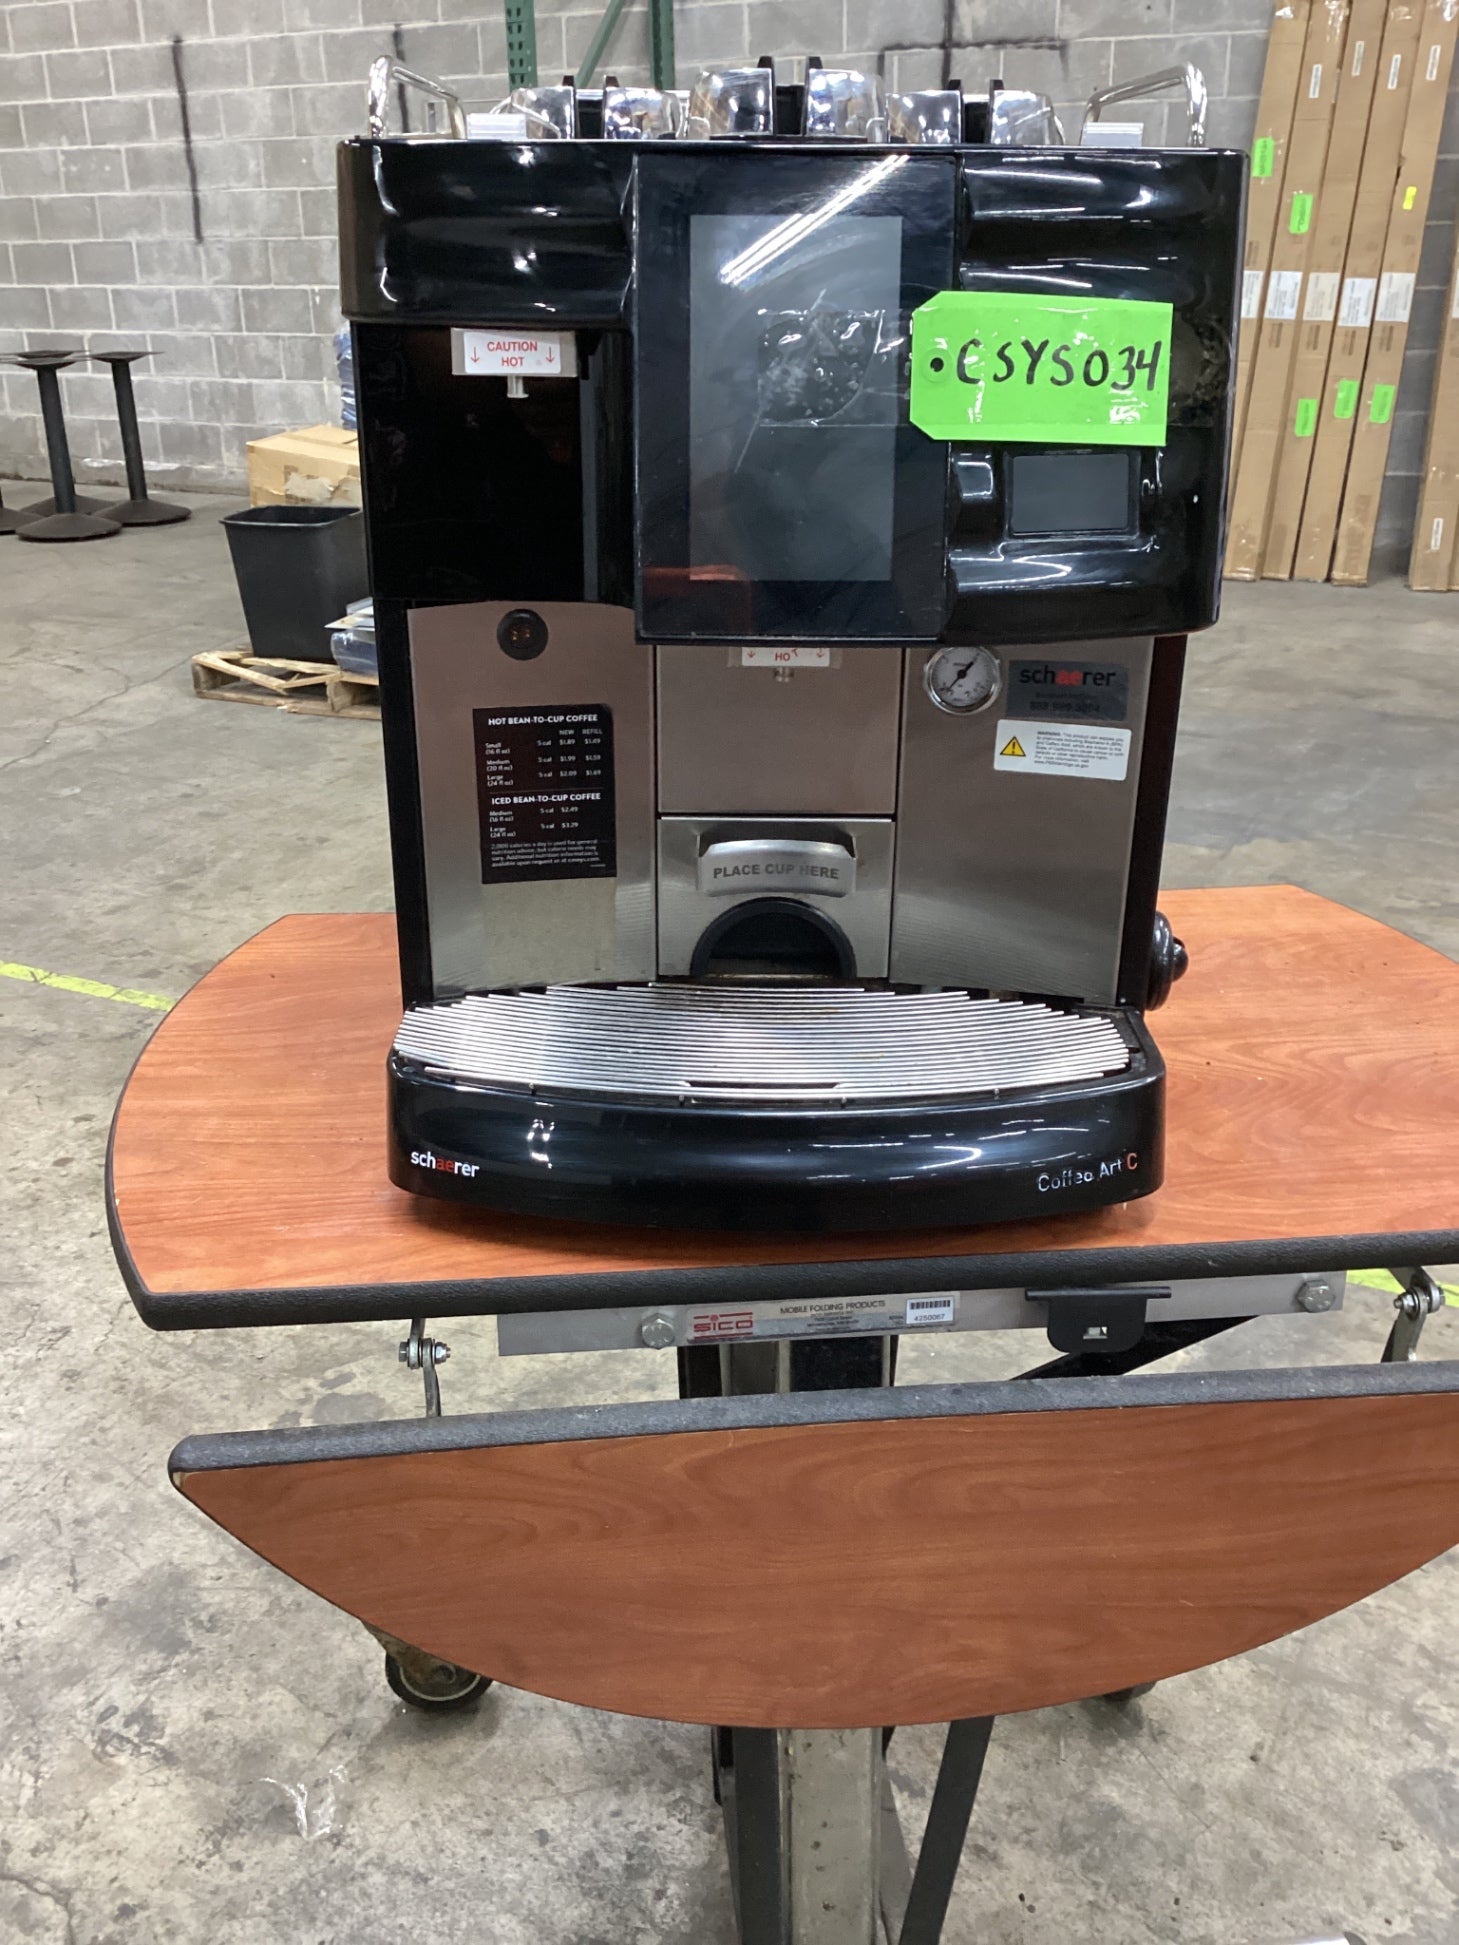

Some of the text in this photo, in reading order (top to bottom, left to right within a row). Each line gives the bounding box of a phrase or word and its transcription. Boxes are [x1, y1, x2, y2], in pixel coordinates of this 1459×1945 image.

[487, 341, 538, 352] CAUTION
[501, 356, 525, 367] HOT
[775, 647, 799, 661] HOT
[1019, 664, 1116, 686] schaerer
[488, 713, 598, 726] HOT BEAN-TO-CUP COFFEE
[491, 793, 601, 805] ICED BEAN-TO-CUP COFFEE
[713, 863, 840, 879] PLACE CUP HERE
[411, 1151, 480, 1177] schaerer
[1099, 1159, 1122, 1178] Art
[1126, 1152, 1138, 1170] C
[780, 1305, 808, 1314] MOBILE
[809, 1302, 843, 1312] FOLDING
[846, 1300, 886, 1309] PRODUCTS
